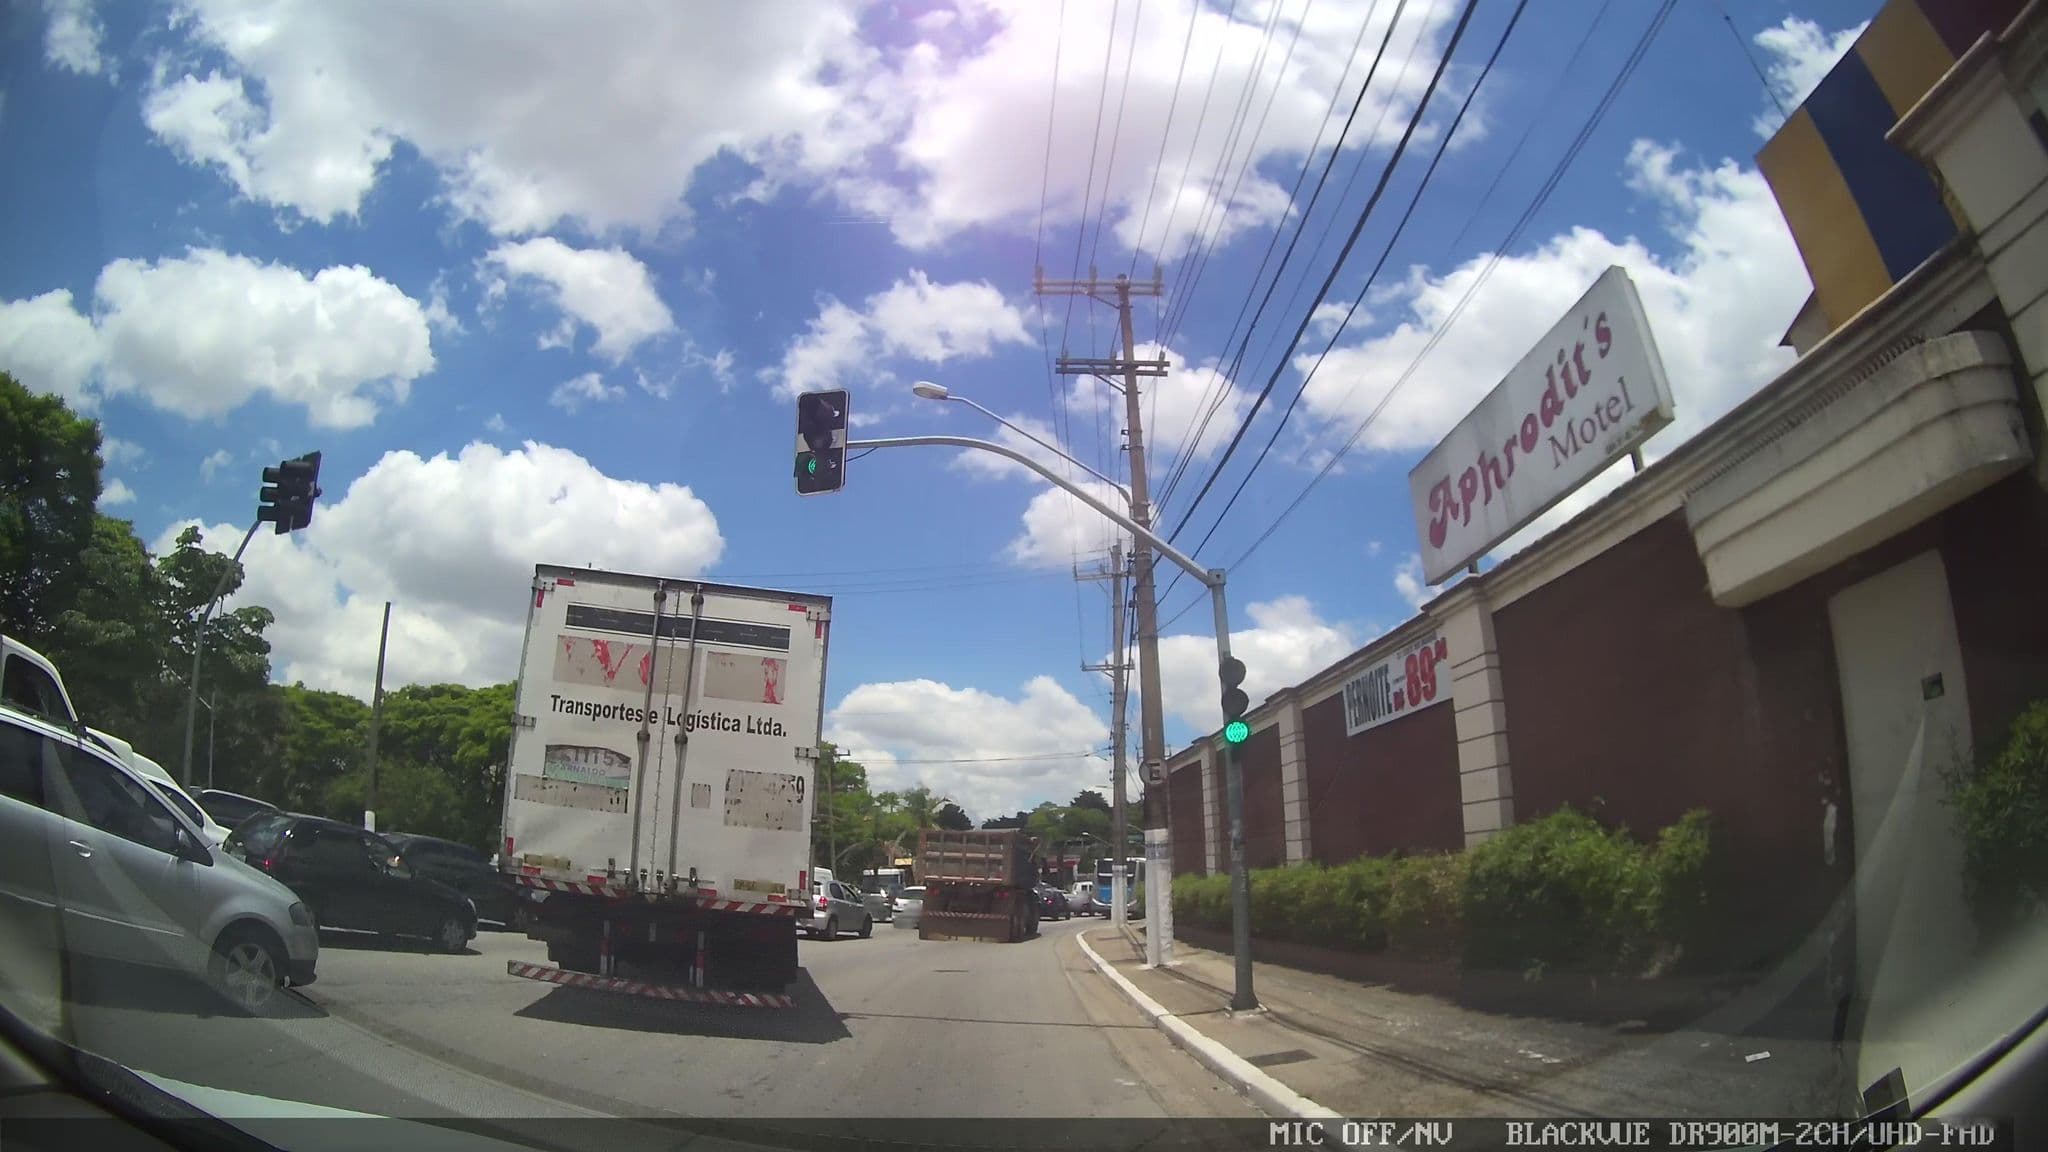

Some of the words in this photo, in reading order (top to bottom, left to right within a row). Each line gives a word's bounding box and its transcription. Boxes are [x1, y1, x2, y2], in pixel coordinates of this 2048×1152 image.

[1429, 312, 1611, 549] Aphrodit's
[1548, 376, 1634, 470] Motel
[550, 694, 643, 723] Transportes
[649, 708, 659, 724] e
[746, 714, 788, 738] Ltda.
